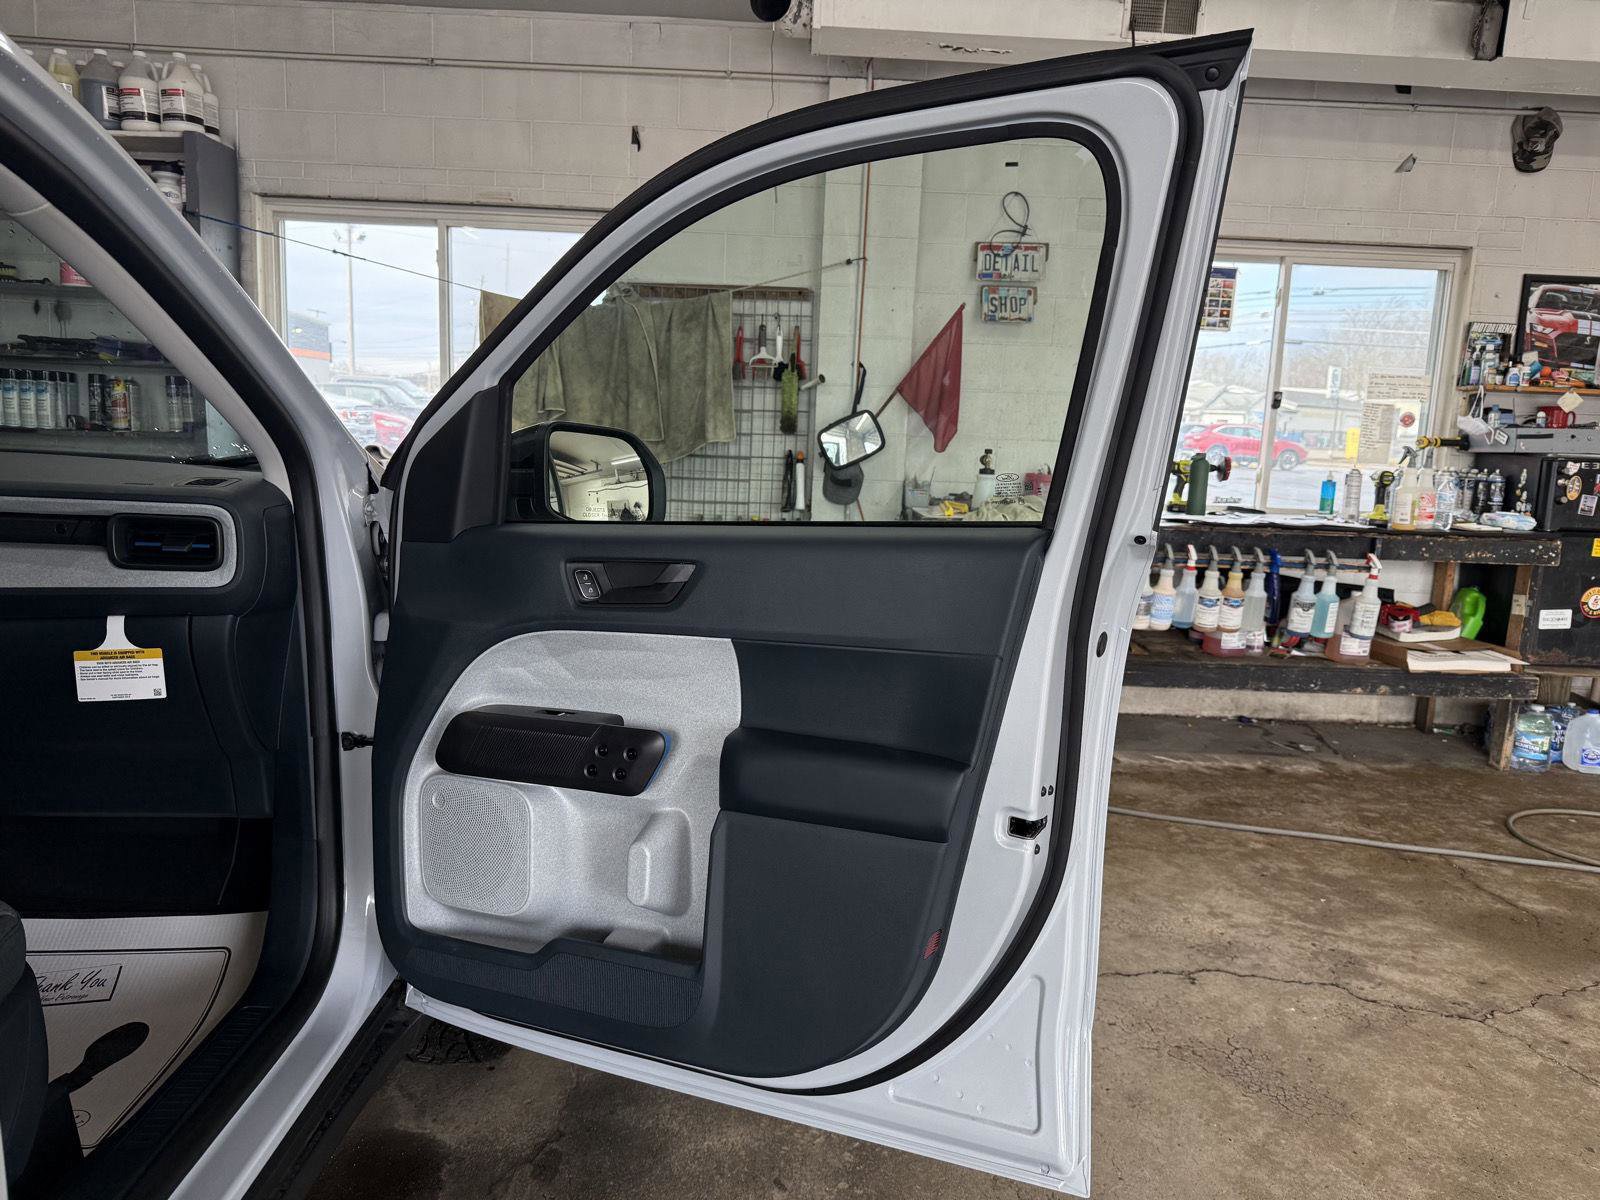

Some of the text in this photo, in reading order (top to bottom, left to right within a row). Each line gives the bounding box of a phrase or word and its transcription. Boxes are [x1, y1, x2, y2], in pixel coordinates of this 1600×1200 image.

[984, 253, 1039, 272] DETAIL
[989, 296, 1027, 314] SHOP
[80, 968, 108, 991] You
